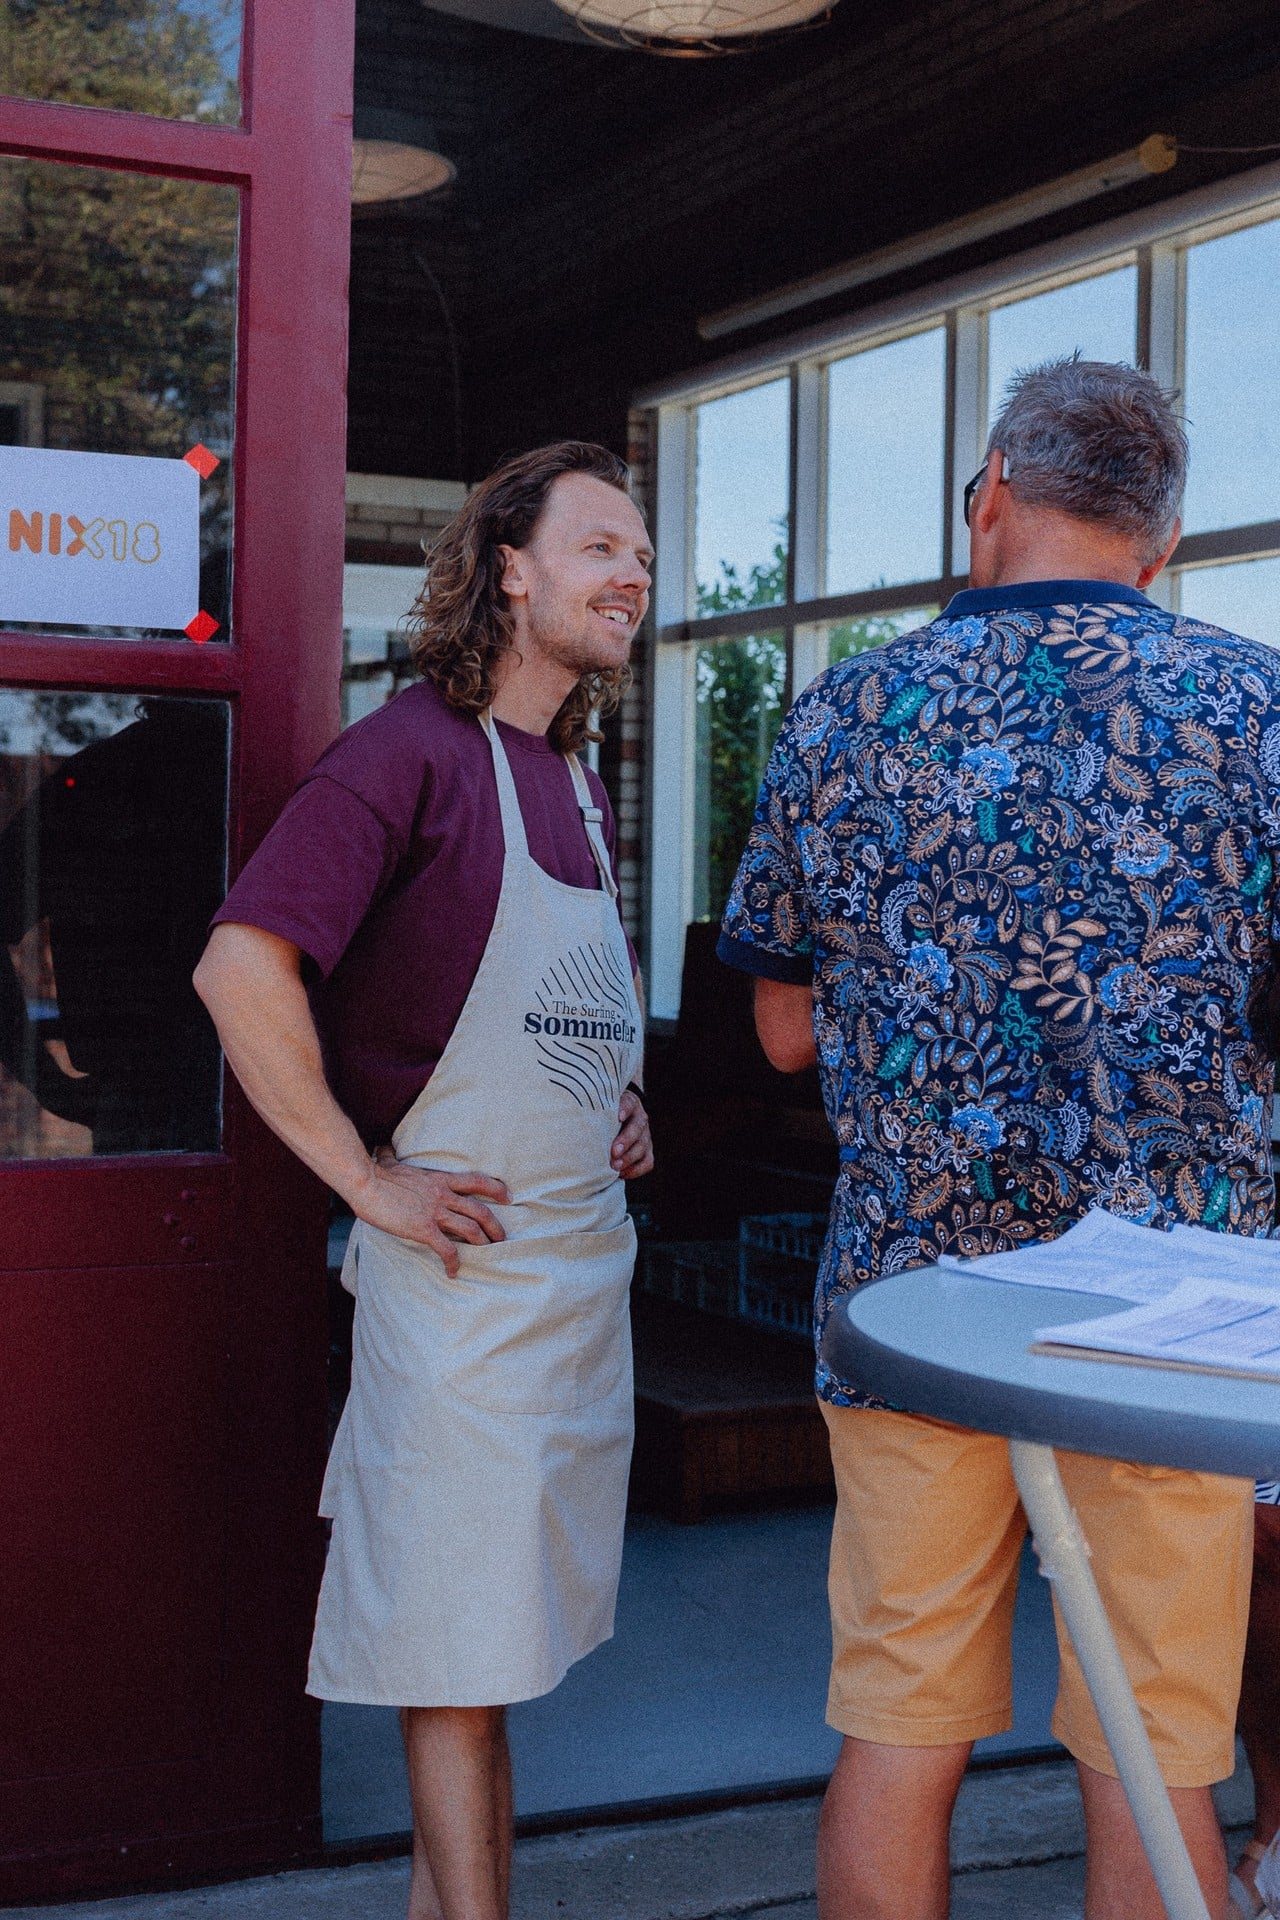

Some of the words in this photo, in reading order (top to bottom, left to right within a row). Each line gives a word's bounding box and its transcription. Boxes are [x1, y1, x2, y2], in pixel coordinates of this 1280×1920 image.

[8, 508, 162, 565] NIX18
[552, 1000, 578, 1016] The
[524, 1012, 636, 1044] Sommeler
